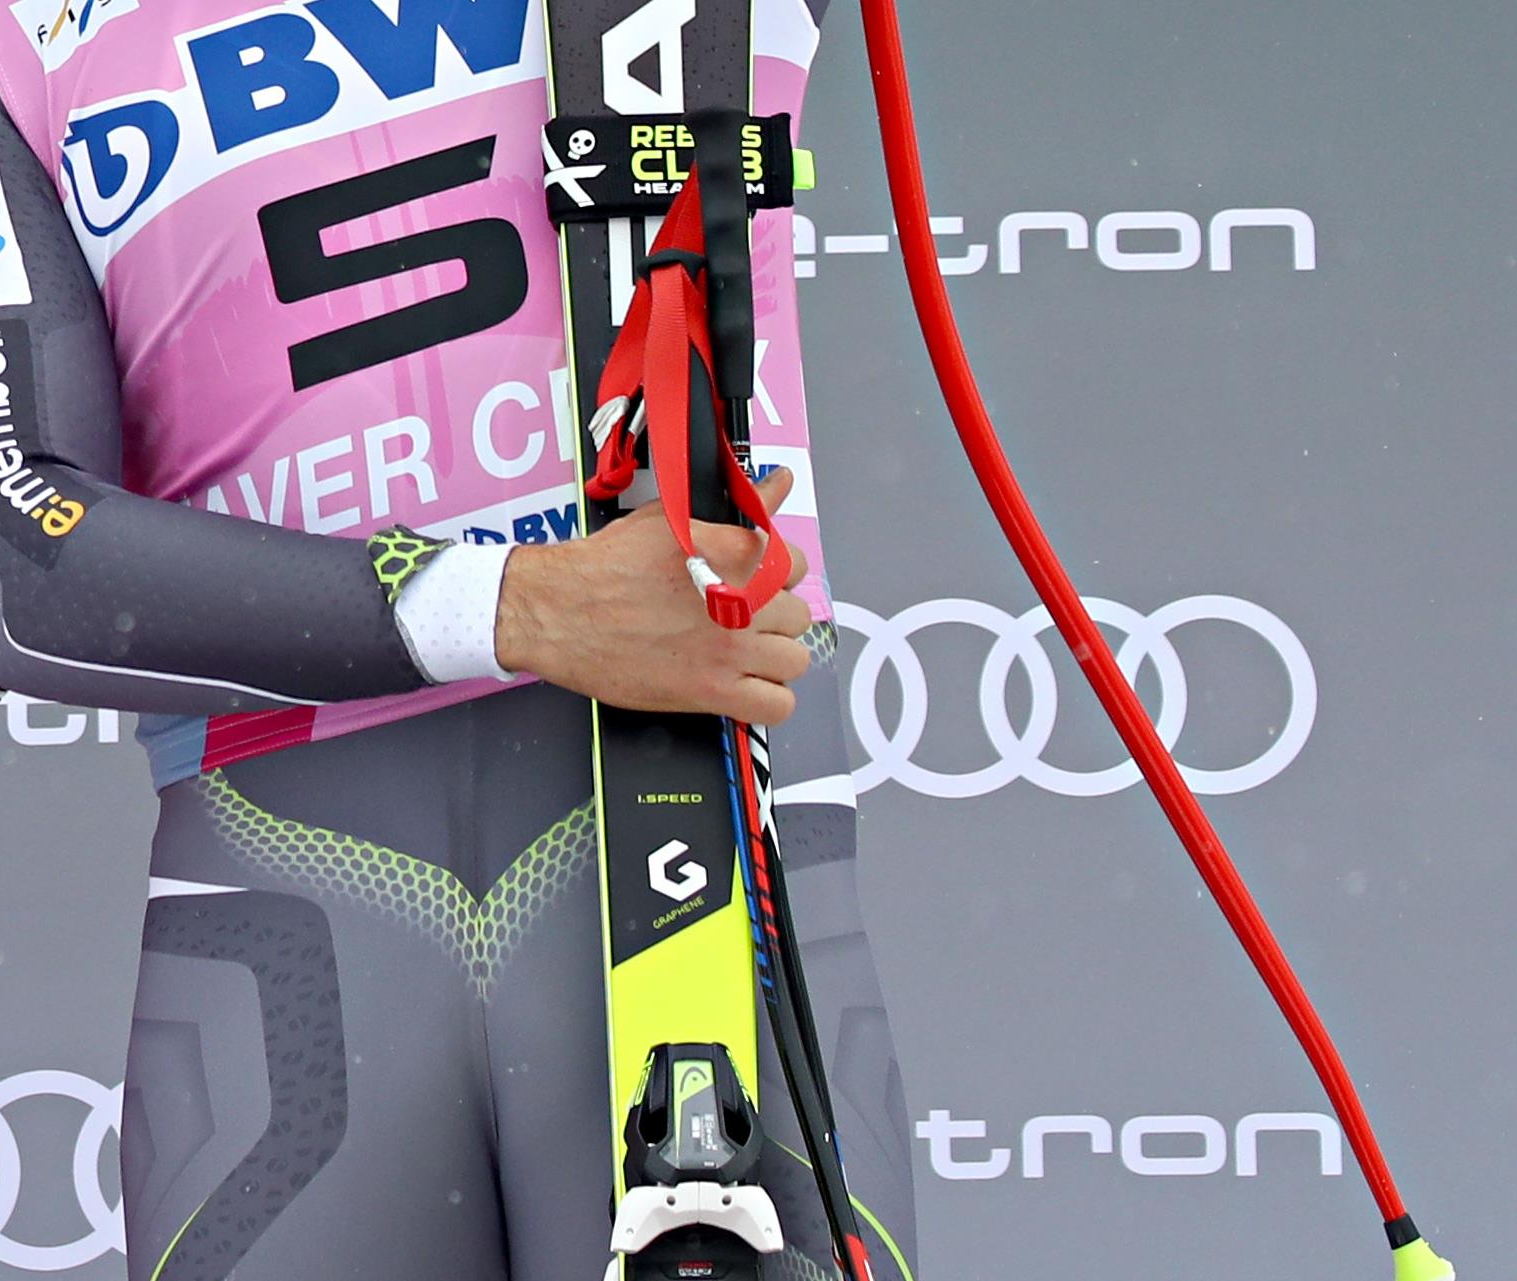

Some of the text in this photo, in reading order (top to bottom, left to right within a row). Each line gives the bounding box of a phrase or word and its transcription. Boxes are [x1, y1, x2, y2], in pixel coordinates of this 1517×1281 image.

[257, 133, 529, 393] 5
[794, 208, 1317, 278] -tron
[652, 895, 705, 930] GRAPHENE
